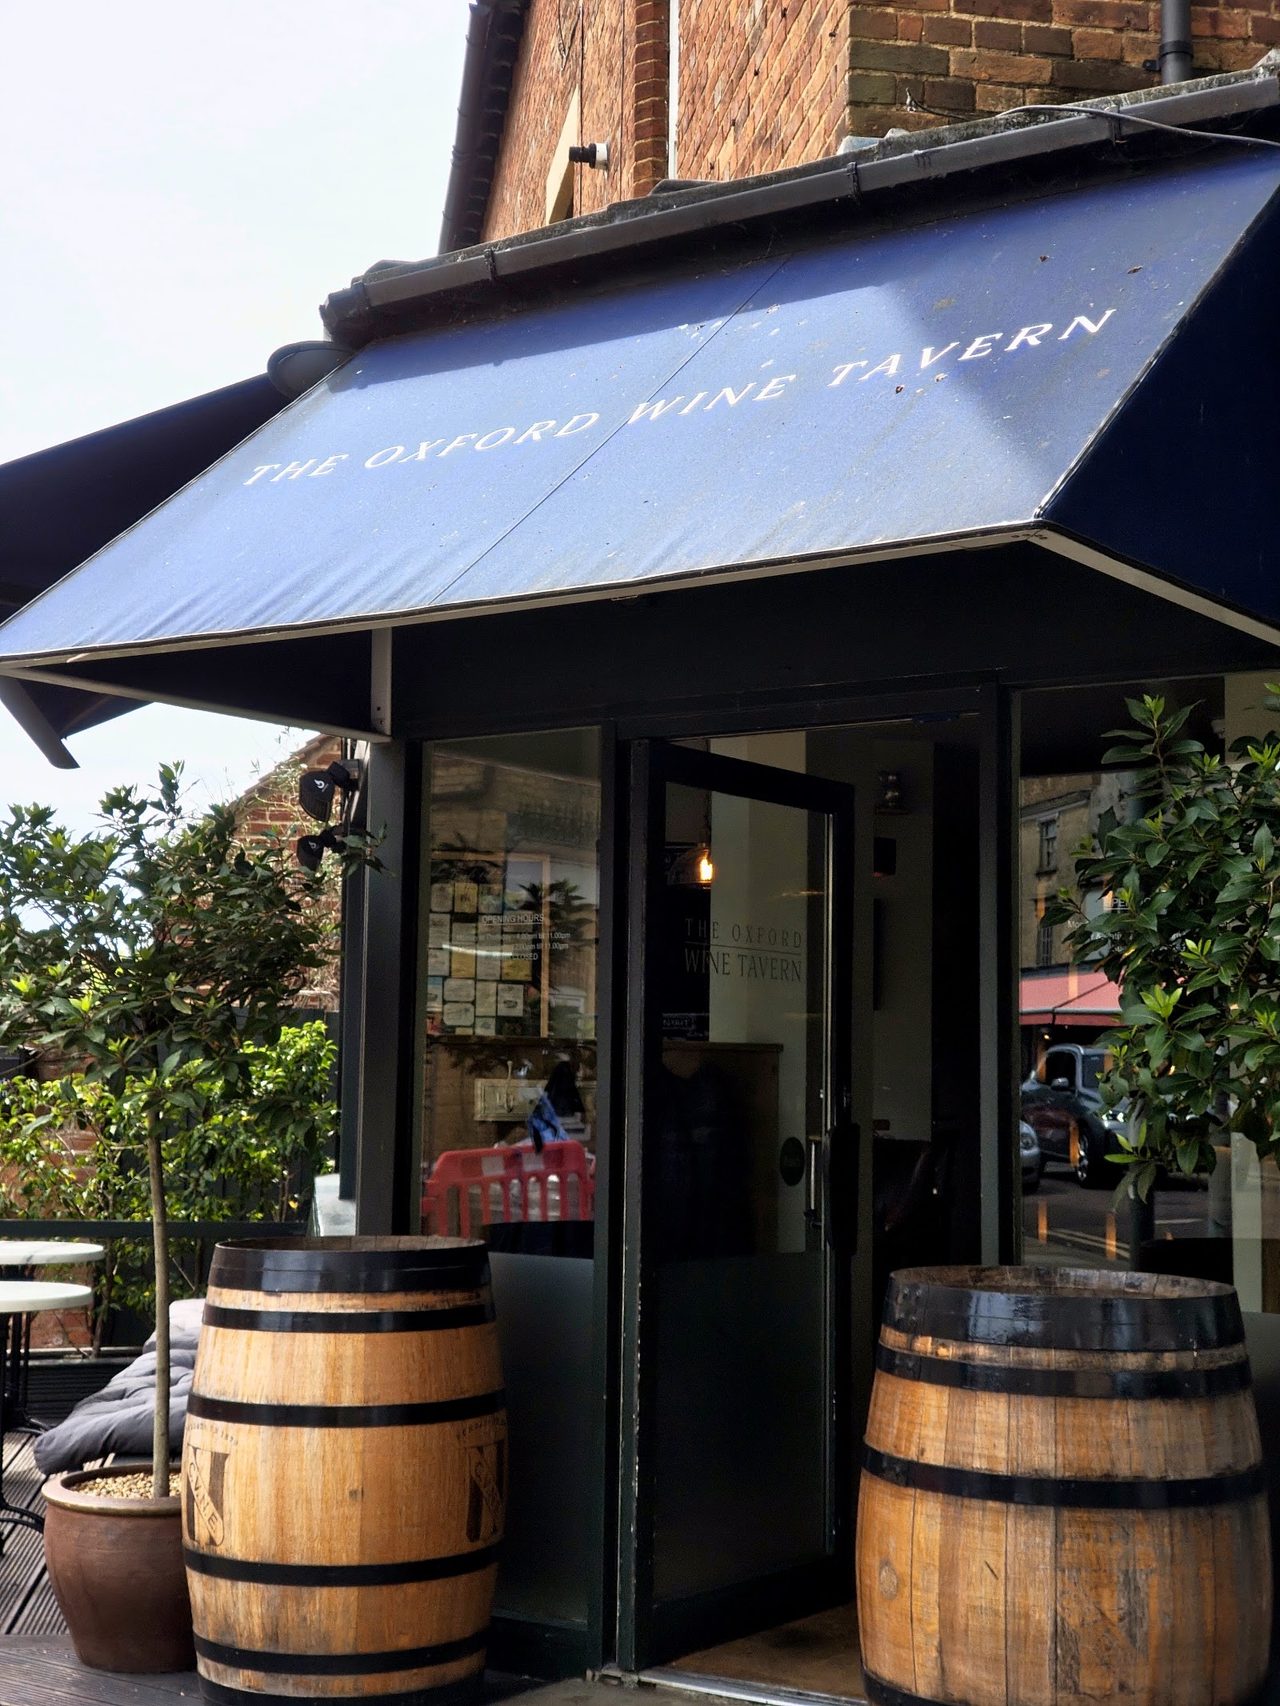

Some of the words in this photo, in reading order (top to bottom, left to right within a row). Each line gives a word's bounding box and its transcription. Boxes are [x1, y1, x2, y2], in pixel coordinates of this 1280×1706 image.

[242, 452, 349, 486] THE
[363, 411, 601, 470] OXFORD
[626, 373, 797, 425] WINE
[826, 307, 1118, 389] TAVERN
[481, 914, 516, 925] OPENING
[517, 913, 544, 923] HOURS
[684, 917, 720, 940] THE
[731, 923, 803, 949] OXFORD
[683, 947, 731, 977] WINE
[738, 953, 803, 982] TAVERN
